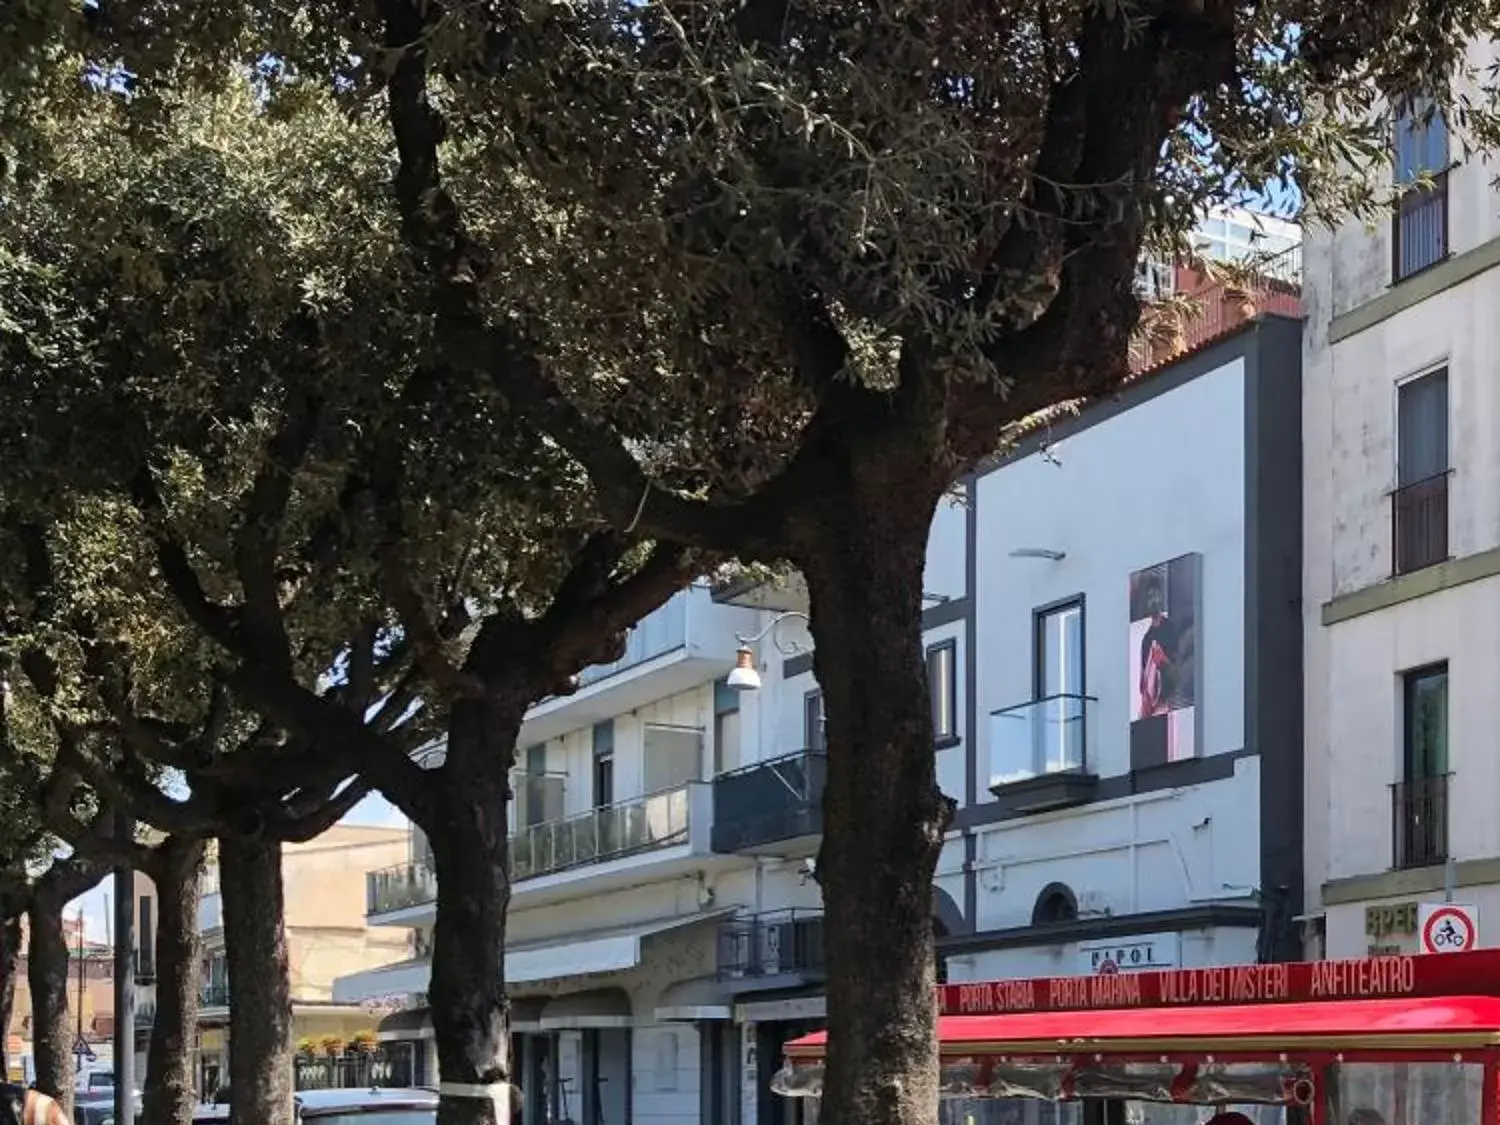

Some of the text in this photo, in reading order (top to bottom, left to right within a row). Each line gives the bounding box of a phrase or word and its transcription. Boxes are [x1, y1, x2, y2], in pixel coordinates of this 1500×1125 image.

[1050, 973, 1141, 1008] PORTA MARINA
[1159, 963, 1289, 1002] VILLA DEI MISTERI
[1311, 956, 1415, 997] ANFITEATRO
[959, 983, 993, 1012] PORTA
[996, 981, 1035, 1010] STABIA
